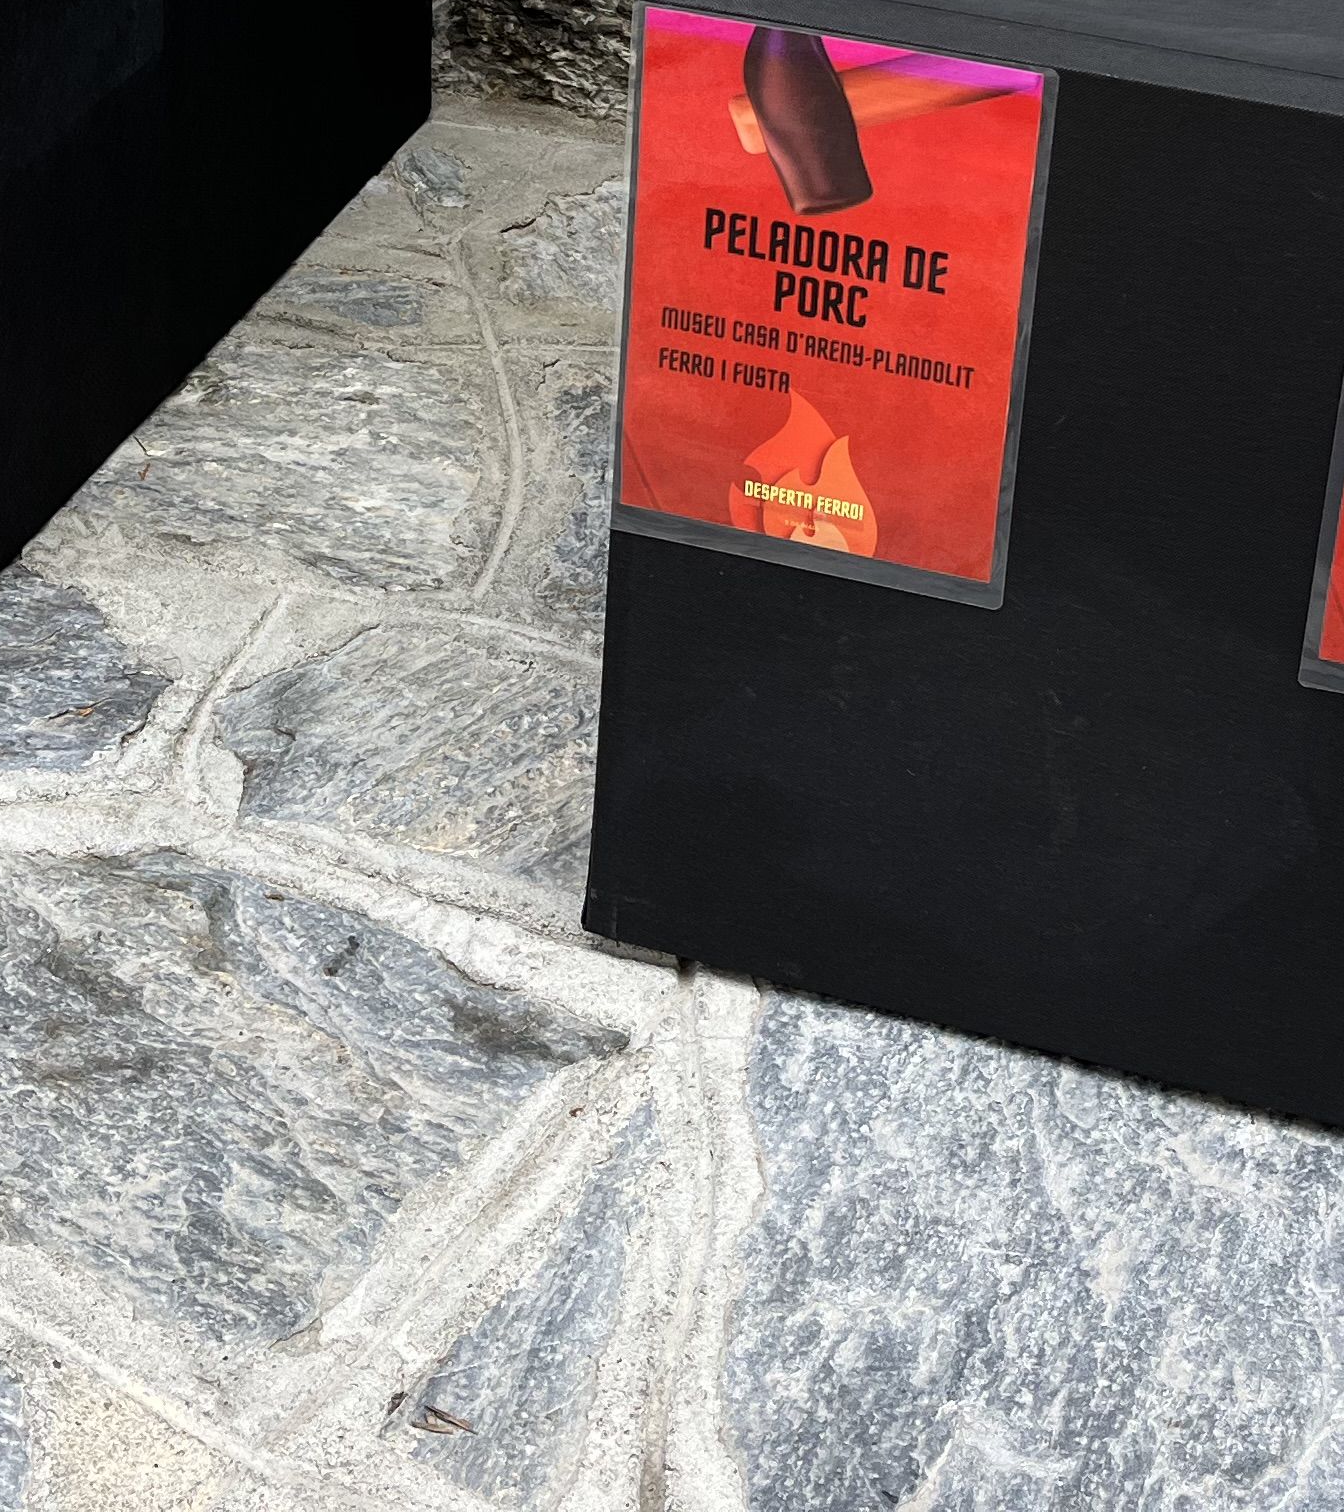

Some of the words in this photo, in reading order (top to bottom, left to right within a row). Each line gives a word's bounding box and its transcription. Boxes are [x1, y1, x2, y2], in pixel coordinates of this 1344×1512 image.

[704, 208, 890, 284] PELADORA
[903, 246, 949, 295] DE
[773, 271, 869, 328] PORC
[658, 347, 714, 378] FERRO
[721, 360, 727, 381] I
[733, 363, 790, 393] FUSTA
[662, 307, 726, 338] MUSEU
[733, 321, 779, 349] CASA
[787, 332, 975, 389] D'ARENY-PLANDOLIT
[744, 480, 813, 509] DESPERTA
[817, 496, 864, 520] FERRO!
